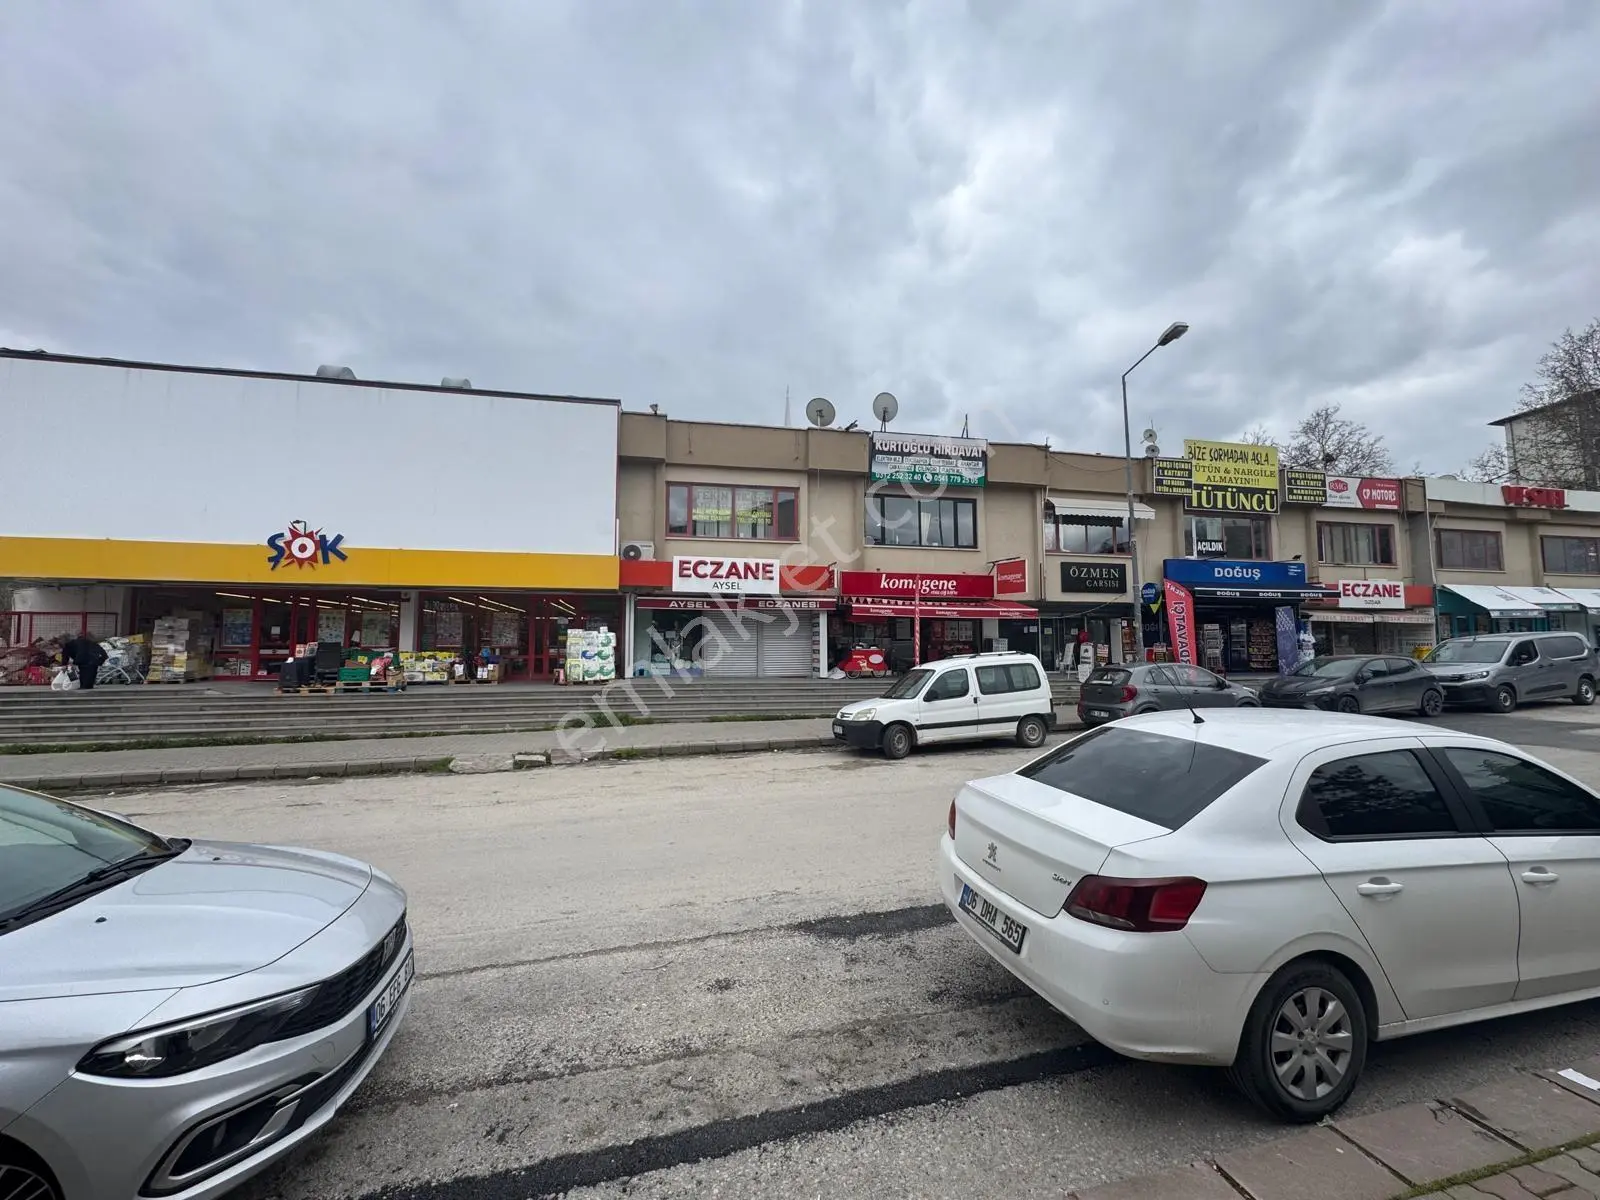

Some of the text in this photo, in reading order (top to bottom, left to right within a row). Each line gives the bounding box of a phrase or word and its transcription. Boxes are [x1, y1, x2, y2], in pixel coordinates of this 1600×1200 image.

[875, 438, 930, 454] KURTOĞLU
[1188, 443, 1208, 460] BİZE
[1193, 463, 1222, 474] ÜTÜN
[1233, 466, 1276, 478] NARGİLE
[1192, 486, 1276, 512] TÜTÜNCÜ
[1372, 489, 1396, 502] MOTORS
[267, 533, 348, 570] ŞOK
[1198, 541, 1223, 554] AÇILDIK
[678, 560, 774, 581] ECZANE
[1070, 566, 1119, 578] ÖZMEN
[1214, 566, 1261, 580] DOĞUŞ
[712, 582, 742, 590] AYSEL
[880, 574, 957, 594] komagene
[1342, 584, 1402, 598] ECZANE
[758, 600, 820, 608] ECZANESİ
[966, 889, 1022, 945] 06 DHA 565
